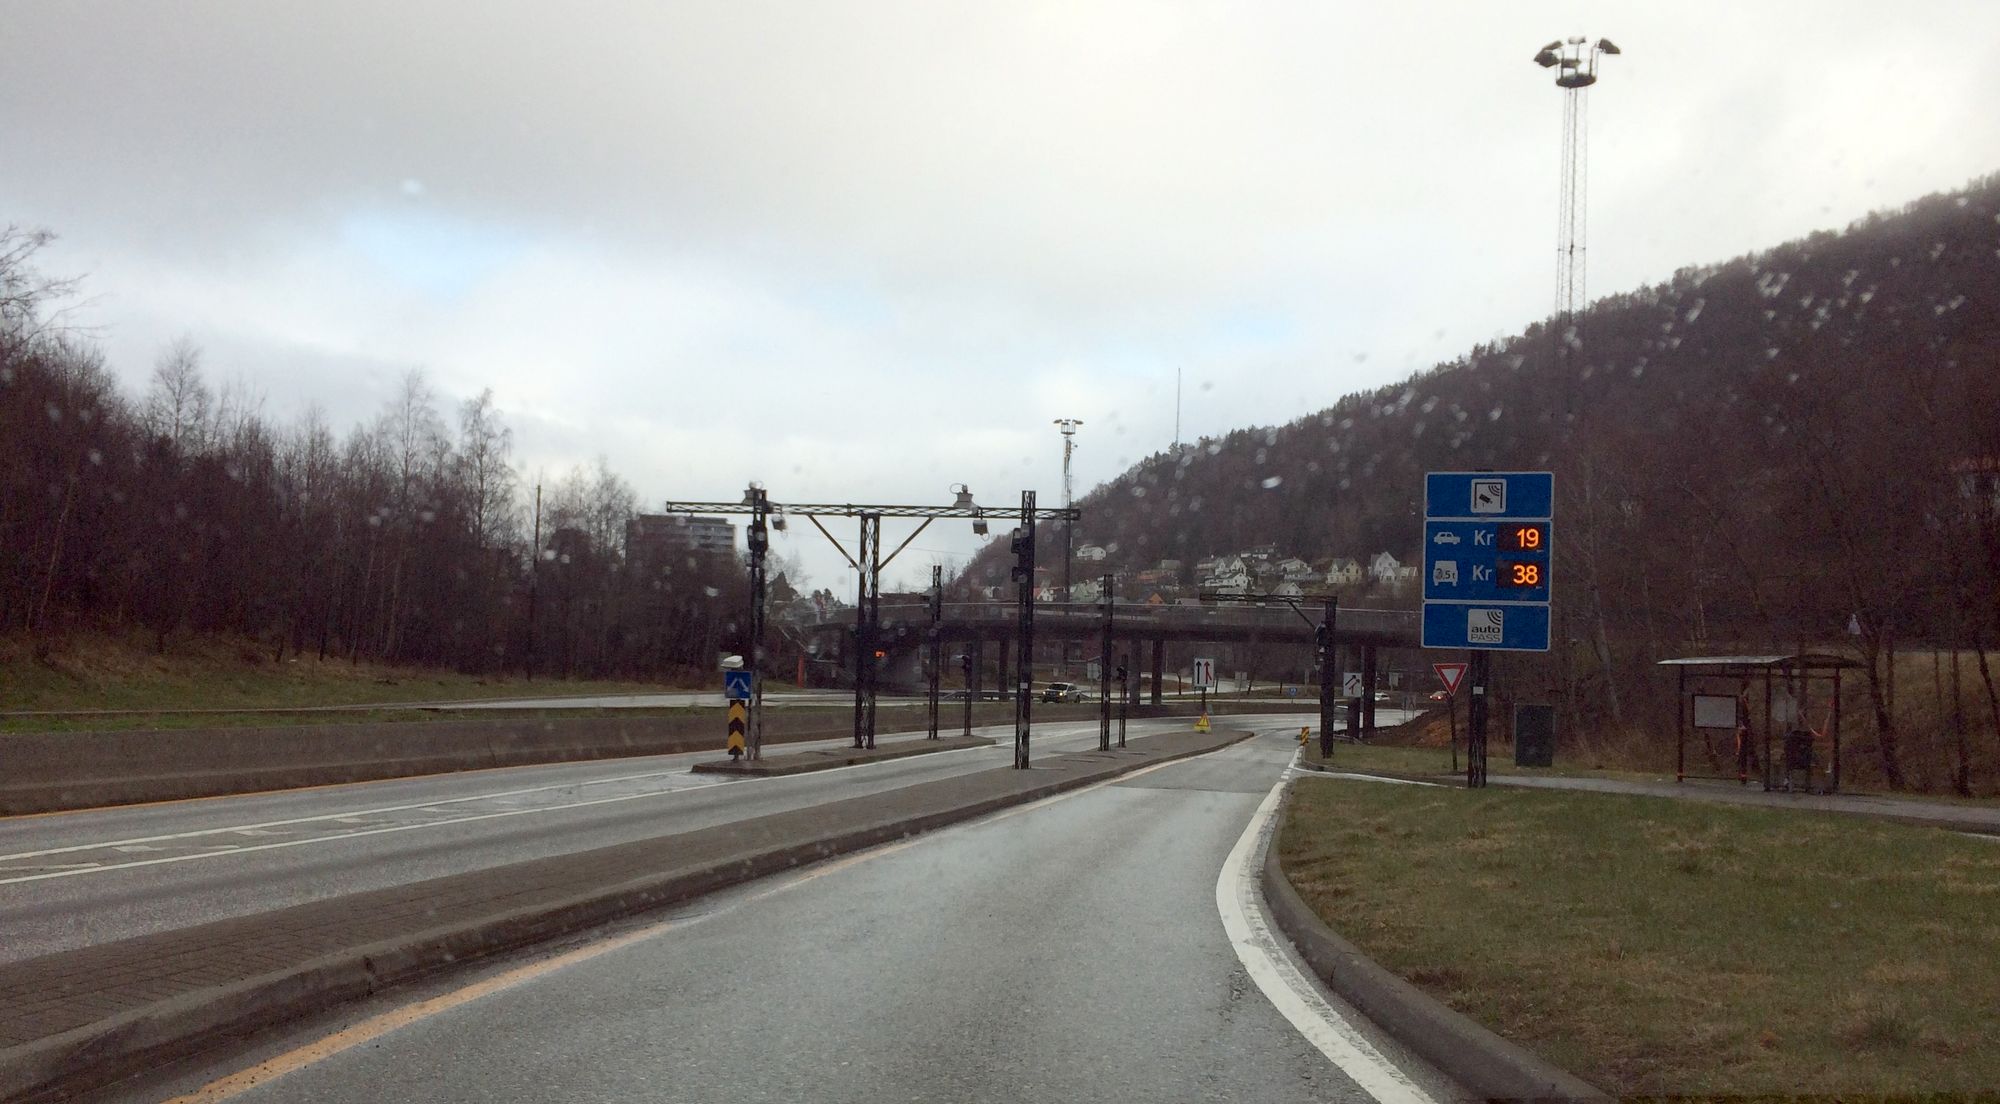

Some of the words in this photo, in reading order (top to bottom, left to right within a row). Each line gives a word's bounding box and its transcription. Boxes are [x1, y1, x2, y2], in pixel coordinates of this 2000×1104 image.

[1474, 530, 1494, 546] Kr
[1517, 528, 1540, 548] 19
[1472, 565, 1492, 581] Kr
[1513, 564, 1538, 584] 38
[1471, 625, 1501, 634] auto
[1471, 633, 1501, 642] PASS
